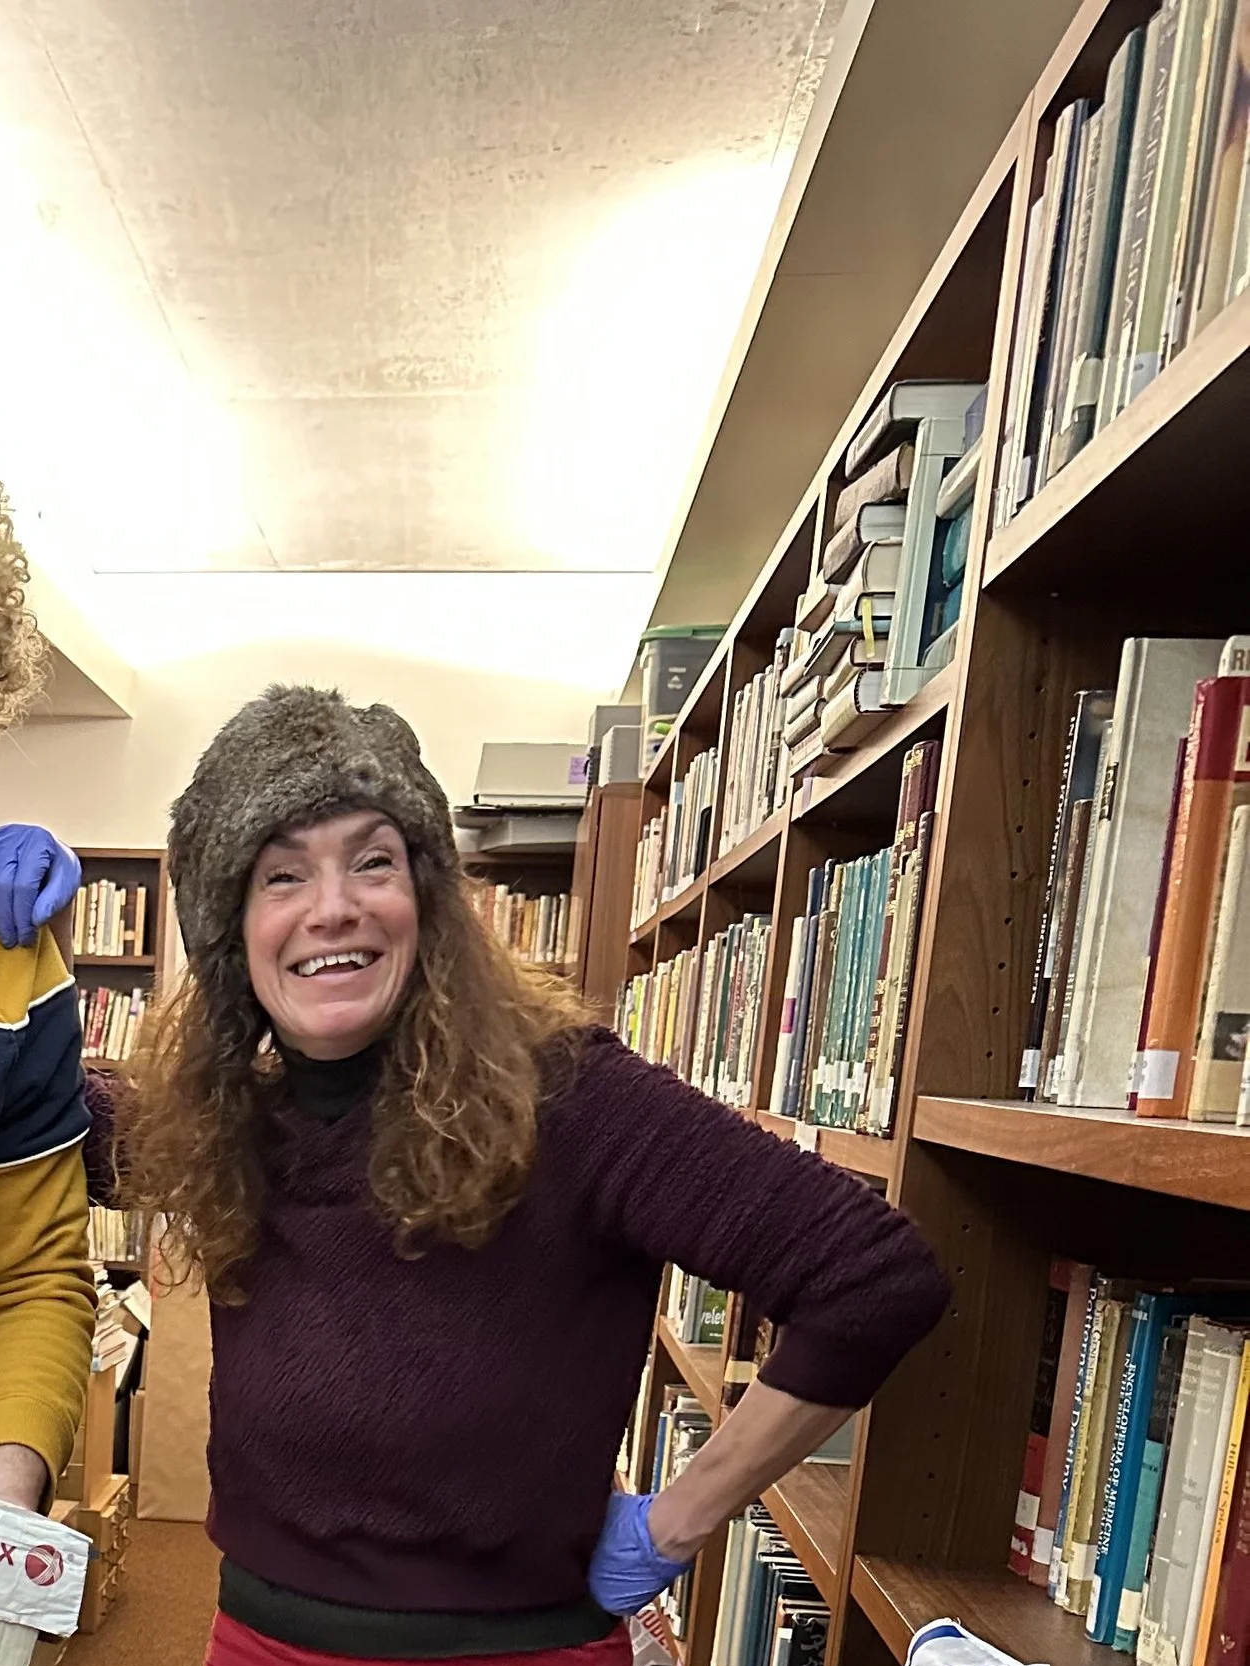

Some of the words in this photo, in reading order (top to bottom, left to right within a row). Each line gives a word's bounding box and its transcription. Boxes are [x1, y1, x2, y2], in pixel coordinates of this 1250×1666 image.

[1061, 1410, 1080, 1491] Destiny
[1112, 1363, 1137, 1471] ENCYCLOPEDIA
[1100, 1485, 1116, 1556] MEDICINE
